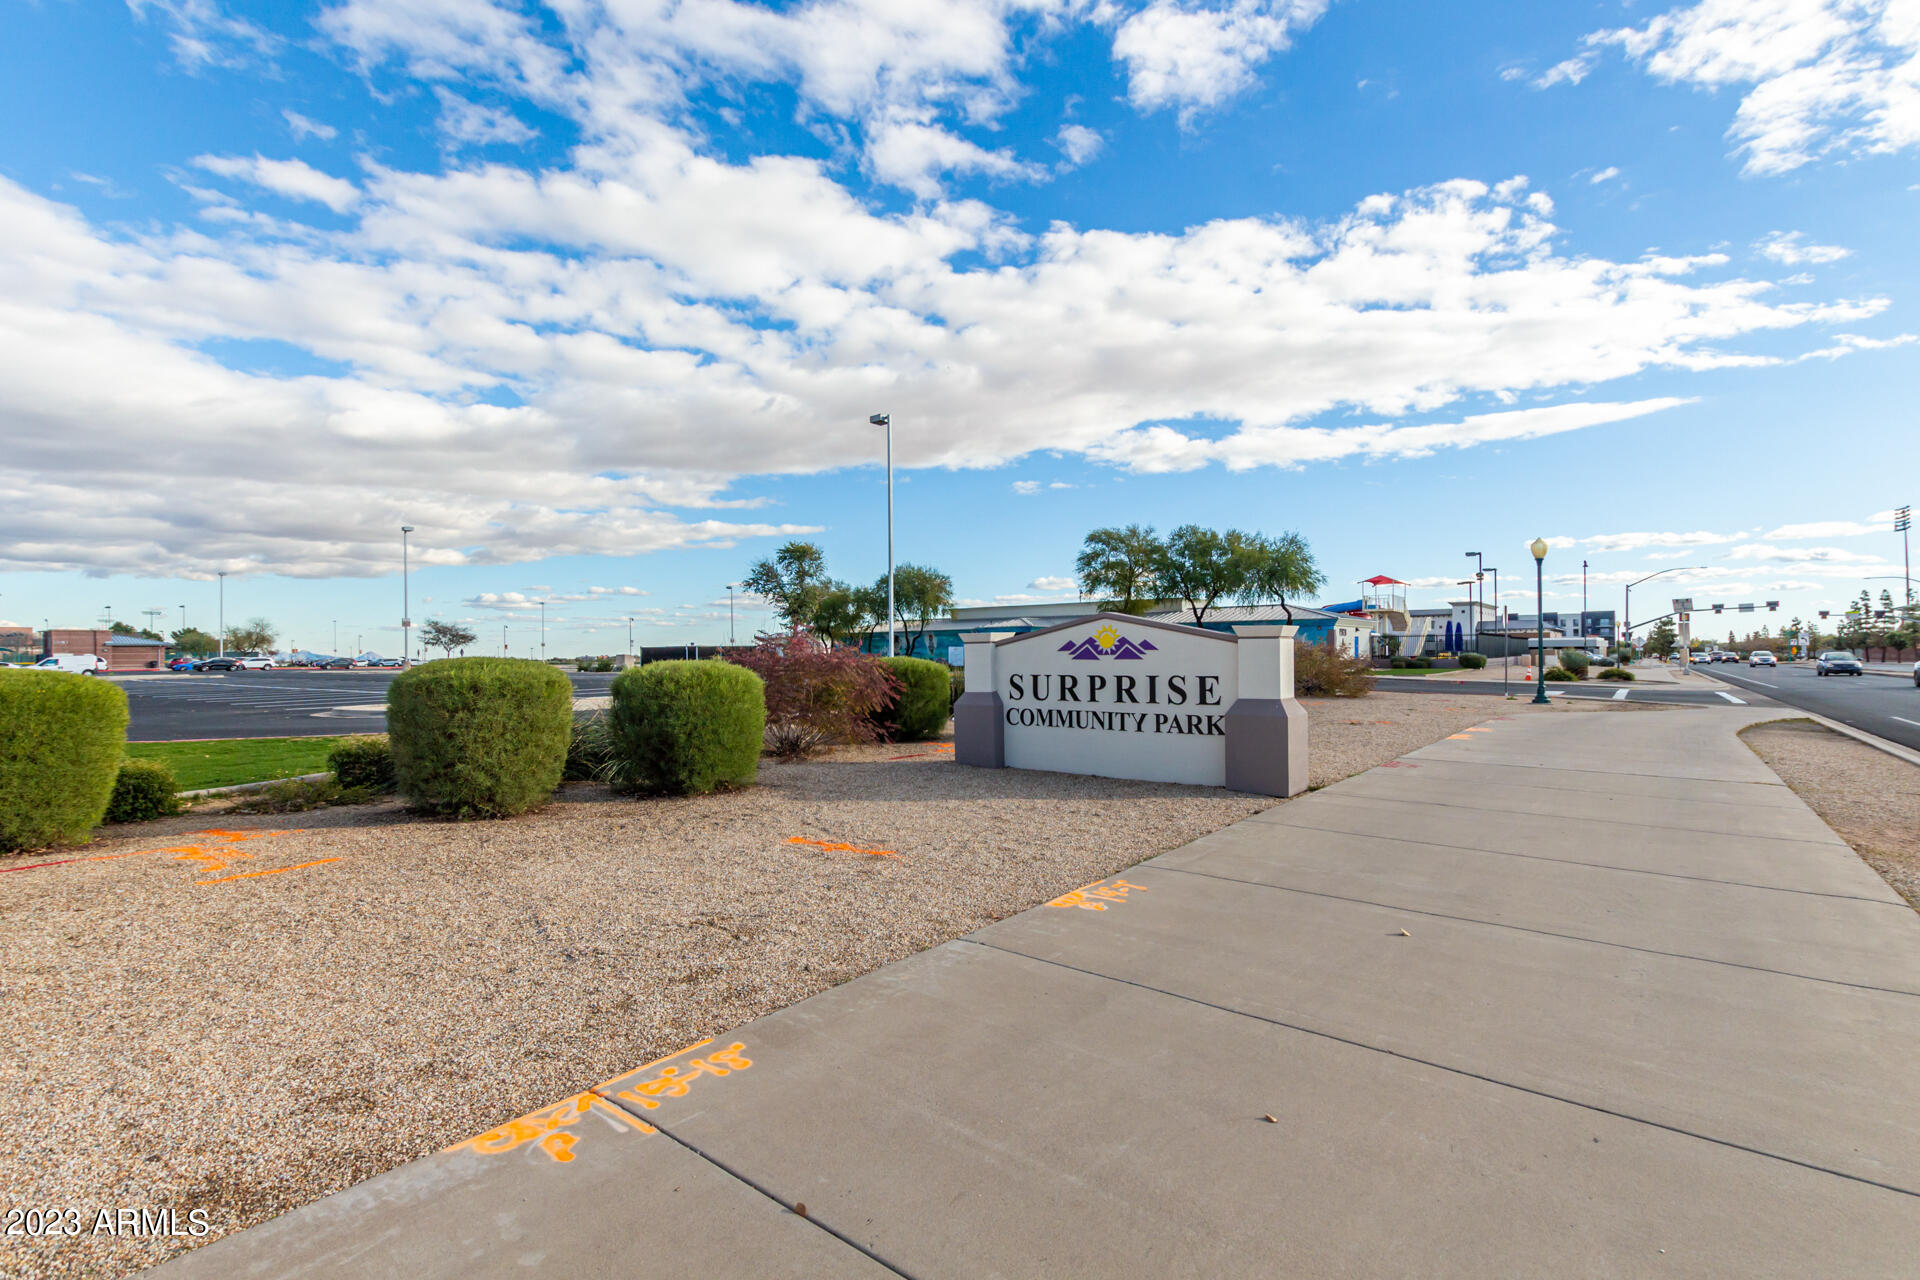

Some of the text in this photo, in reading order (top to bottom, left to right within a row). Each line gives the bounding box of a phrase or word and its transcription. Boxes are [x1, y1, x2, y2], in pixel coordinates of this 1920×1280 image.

[1008, 673, 1222, 706] SURPRISE
[1005, 707, 1226, 736] COMMUNITY PARK
